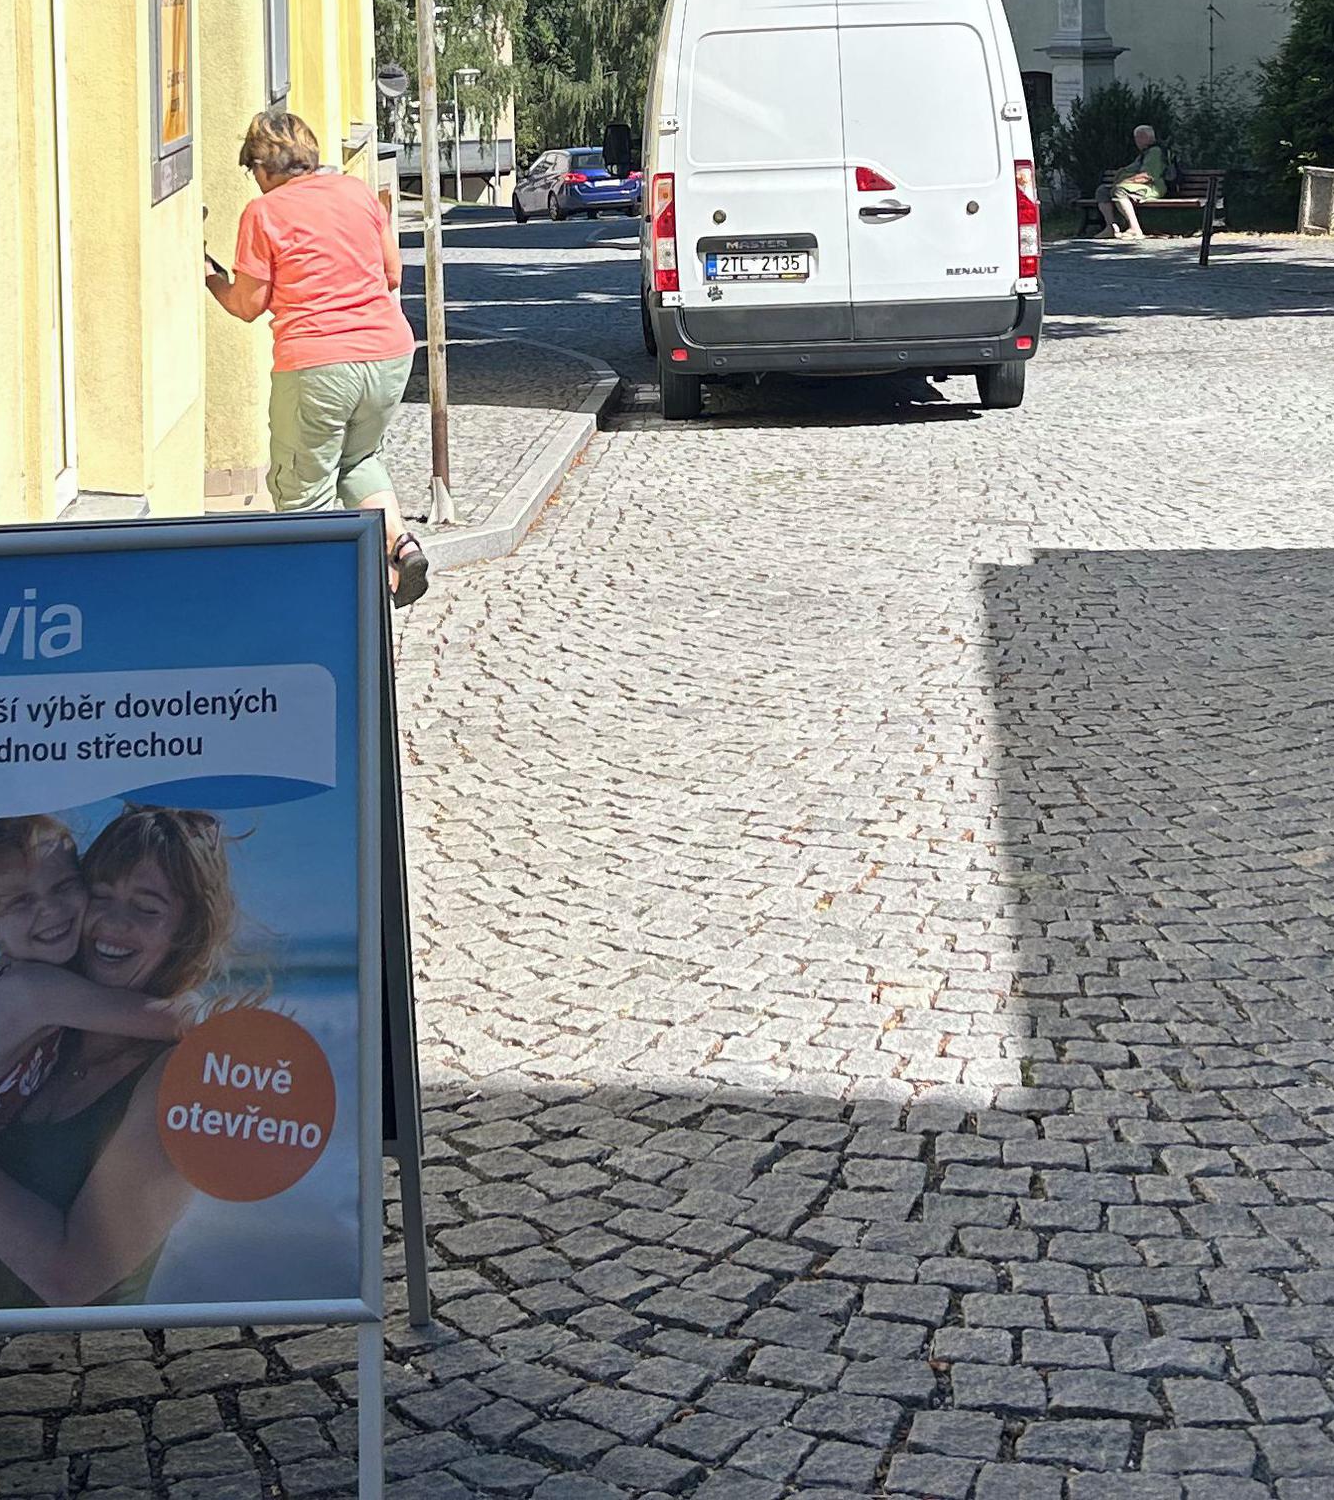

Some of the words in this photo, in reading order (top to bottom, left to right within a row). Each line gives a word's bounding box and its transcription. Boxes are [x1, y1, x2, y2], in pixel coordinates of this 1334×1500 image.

[726, 239, 788, 250] MASTER
[721, 257, 748, 273] 2TL
[761, 255, 800, 271] 2135
[946, 266, 1000, 275] RENAULT
[26, 692, 106, 729] výběr
[114, 686, 278, 722] dovolených
[76, 730, 204, 762] střechou
[202, 1052, 292, 1095] Nově
[167, 1101, 322, 1150] otevřeno
